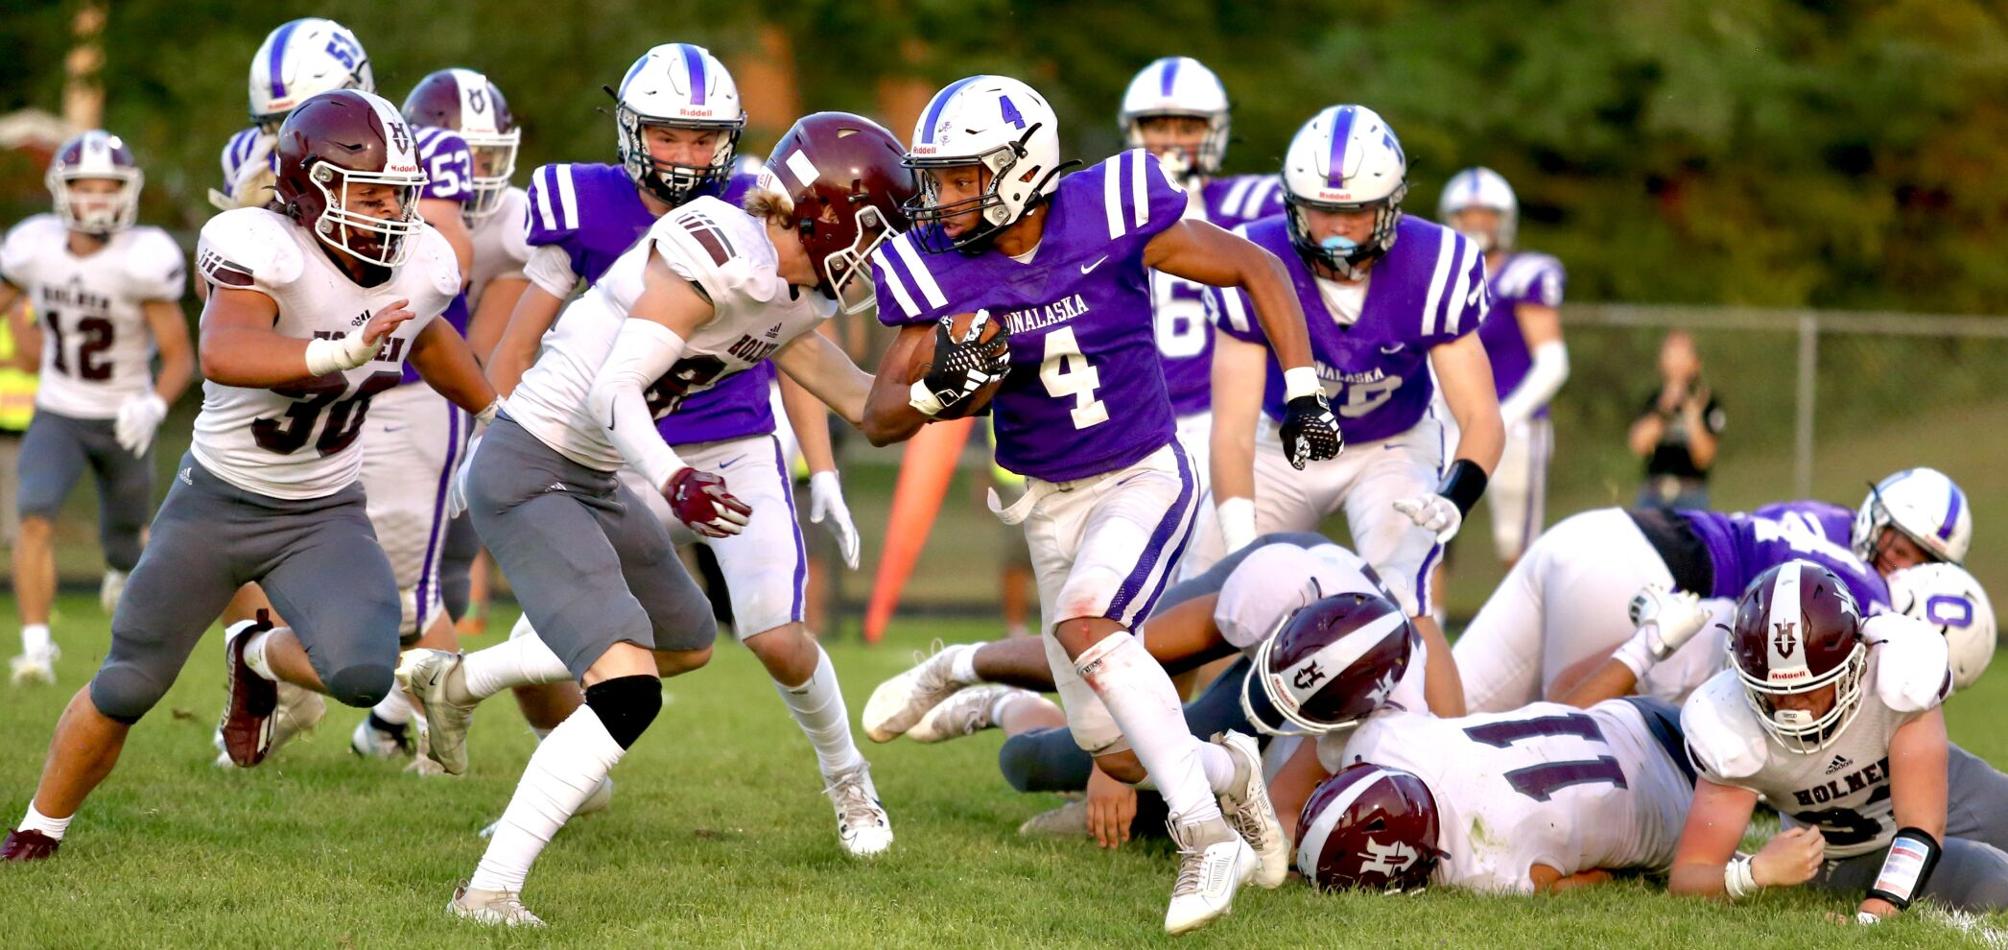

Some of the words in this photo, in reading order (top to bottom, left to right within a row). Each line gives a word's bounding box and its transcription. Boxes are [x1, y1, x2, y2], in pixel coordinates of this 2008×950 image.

[999, 95, 1026, 130] 4
[430, 149, 473, 198] 53
[46, 311, 114, 383] 12
[1148, 267, 1207, 358] 6
[1039, 325, 1110, 431] 4
[1314, 360, 1385, 384] NALASKA
[250, 369, 403, 458] 30
[1462, 712, 1629, 803] 11
[1825, 758, 1854, 776] adidas
